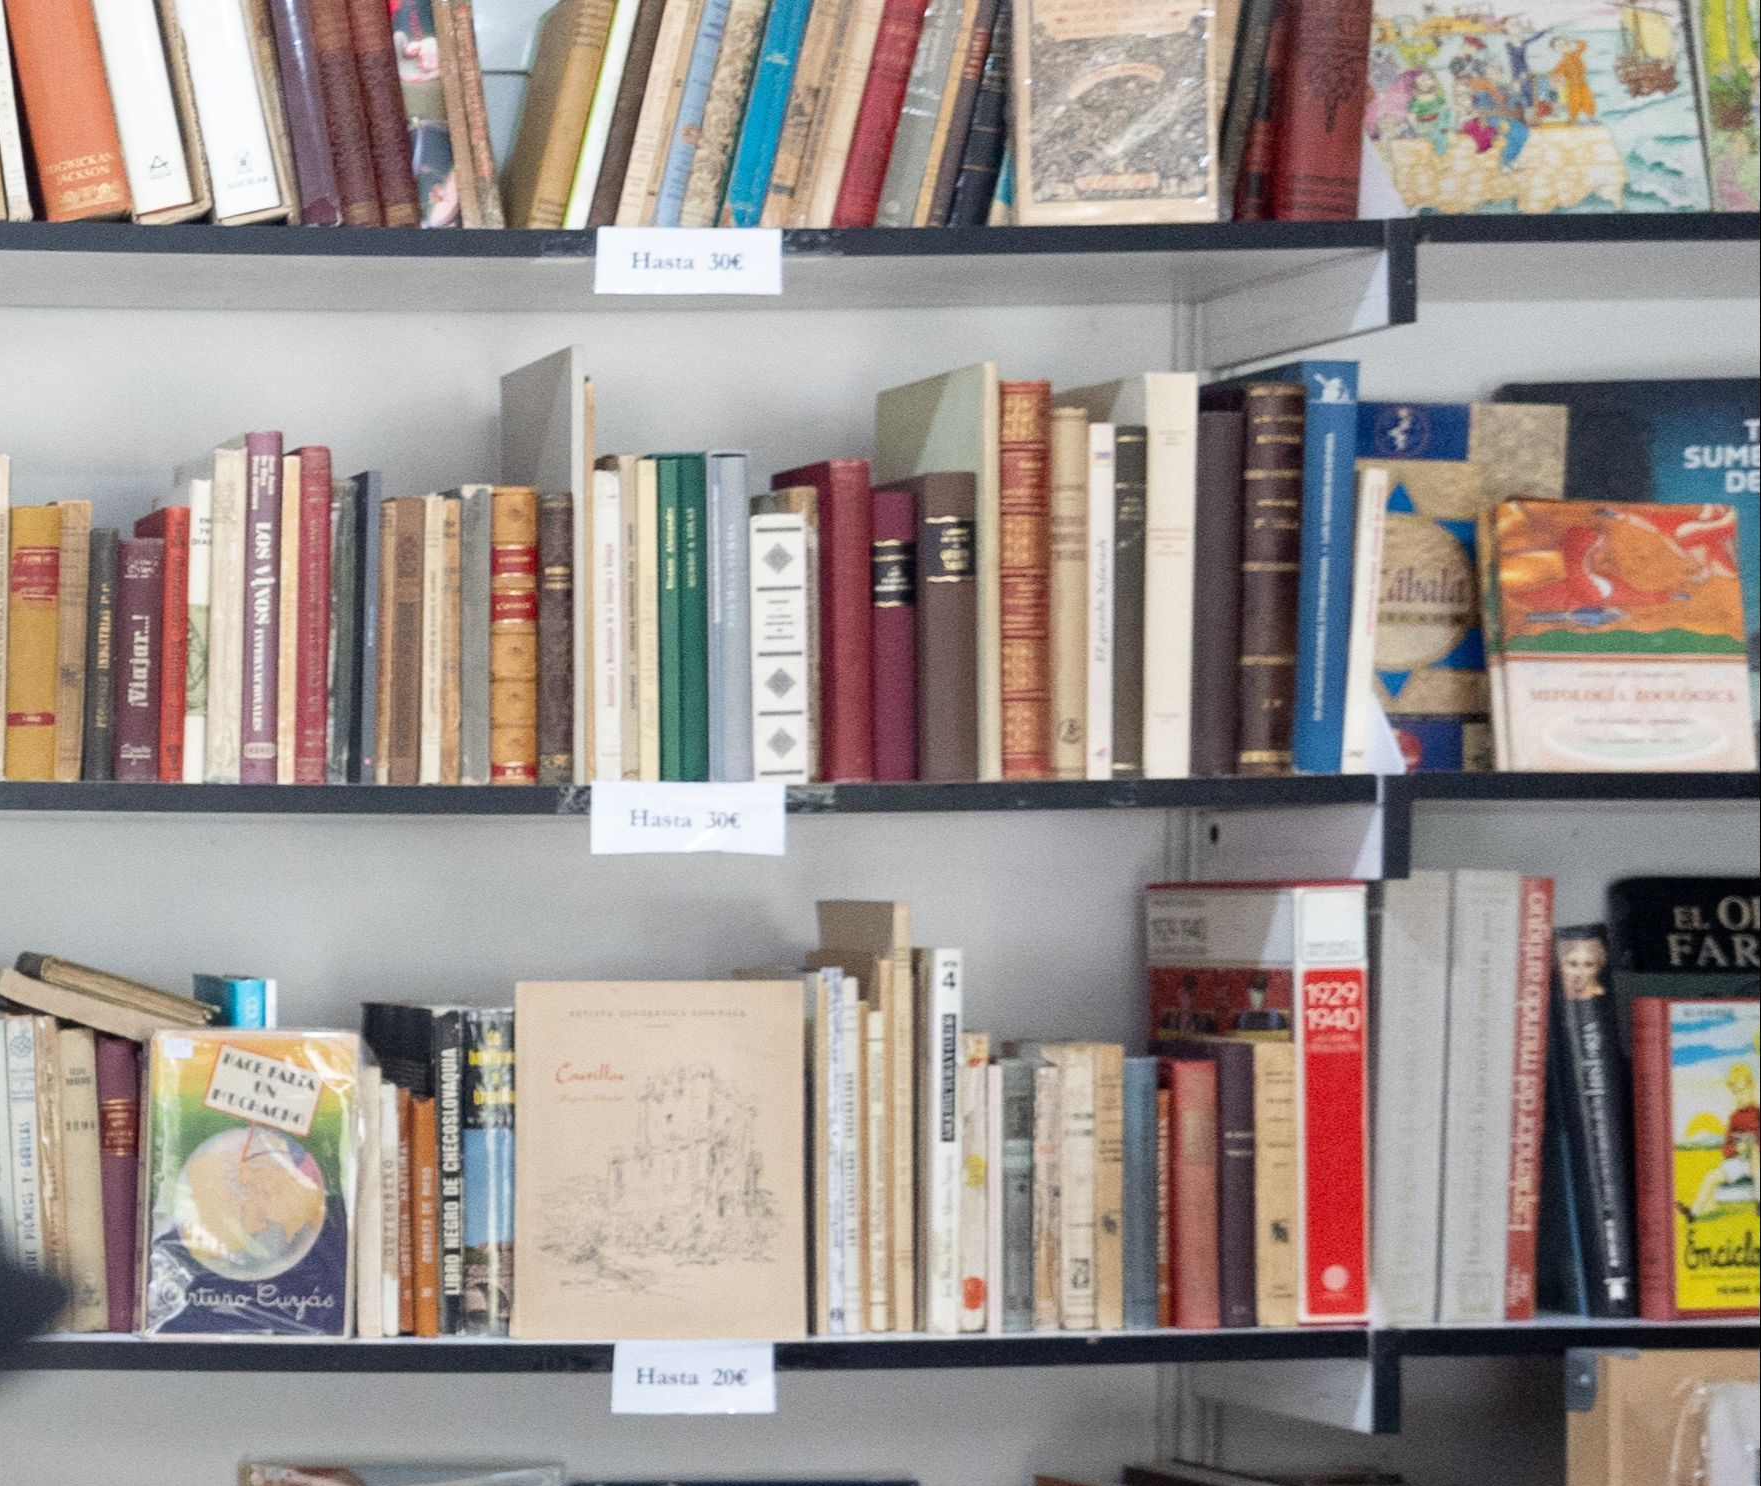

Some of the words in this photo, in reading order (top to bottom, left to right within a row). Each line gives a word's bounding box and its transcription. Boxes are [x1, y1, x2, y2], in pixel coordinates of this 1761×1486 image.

[631, 250, 695, 271] Hasta
[708, 251, 743, 272] 30€
[254, 522, 272, 560] LOS
[250, 565, 275, 625] VINOS
[252, 629, 264, 731] INTERNACIONALES
[629, 808, 691, 831] Hasta
[705, 810, 740, 830] 30€
[1673, 907, 1708, 930] EL
[1520, 893, 1549, 980] antiguo
[942, 972, 955, 989] 4
[1305, 982, 1359, 1006] 1929
[1306, 1008, 1360, 1032] 1940
[1515, 986, 1540, 1068] mundo
[224, 1053, 262, 1075] HACE
[1514, 1073, 1536, 1107] del
[441, 1047, 459, 1172] CHECOSLOVAQUIA
[450, 1177, 459, 1196] DE
[1508, 1115, 1539, 1232] Esplendor
[444, 1201, 460, 1249] NEGRO
[445, 1254, 460, 1295] LIBRO
[257, 1283, 335, 1320] Cuyás
[636, 1367, 699, 1387] Hasta
[712, 1368, 748, 1387] 20€
